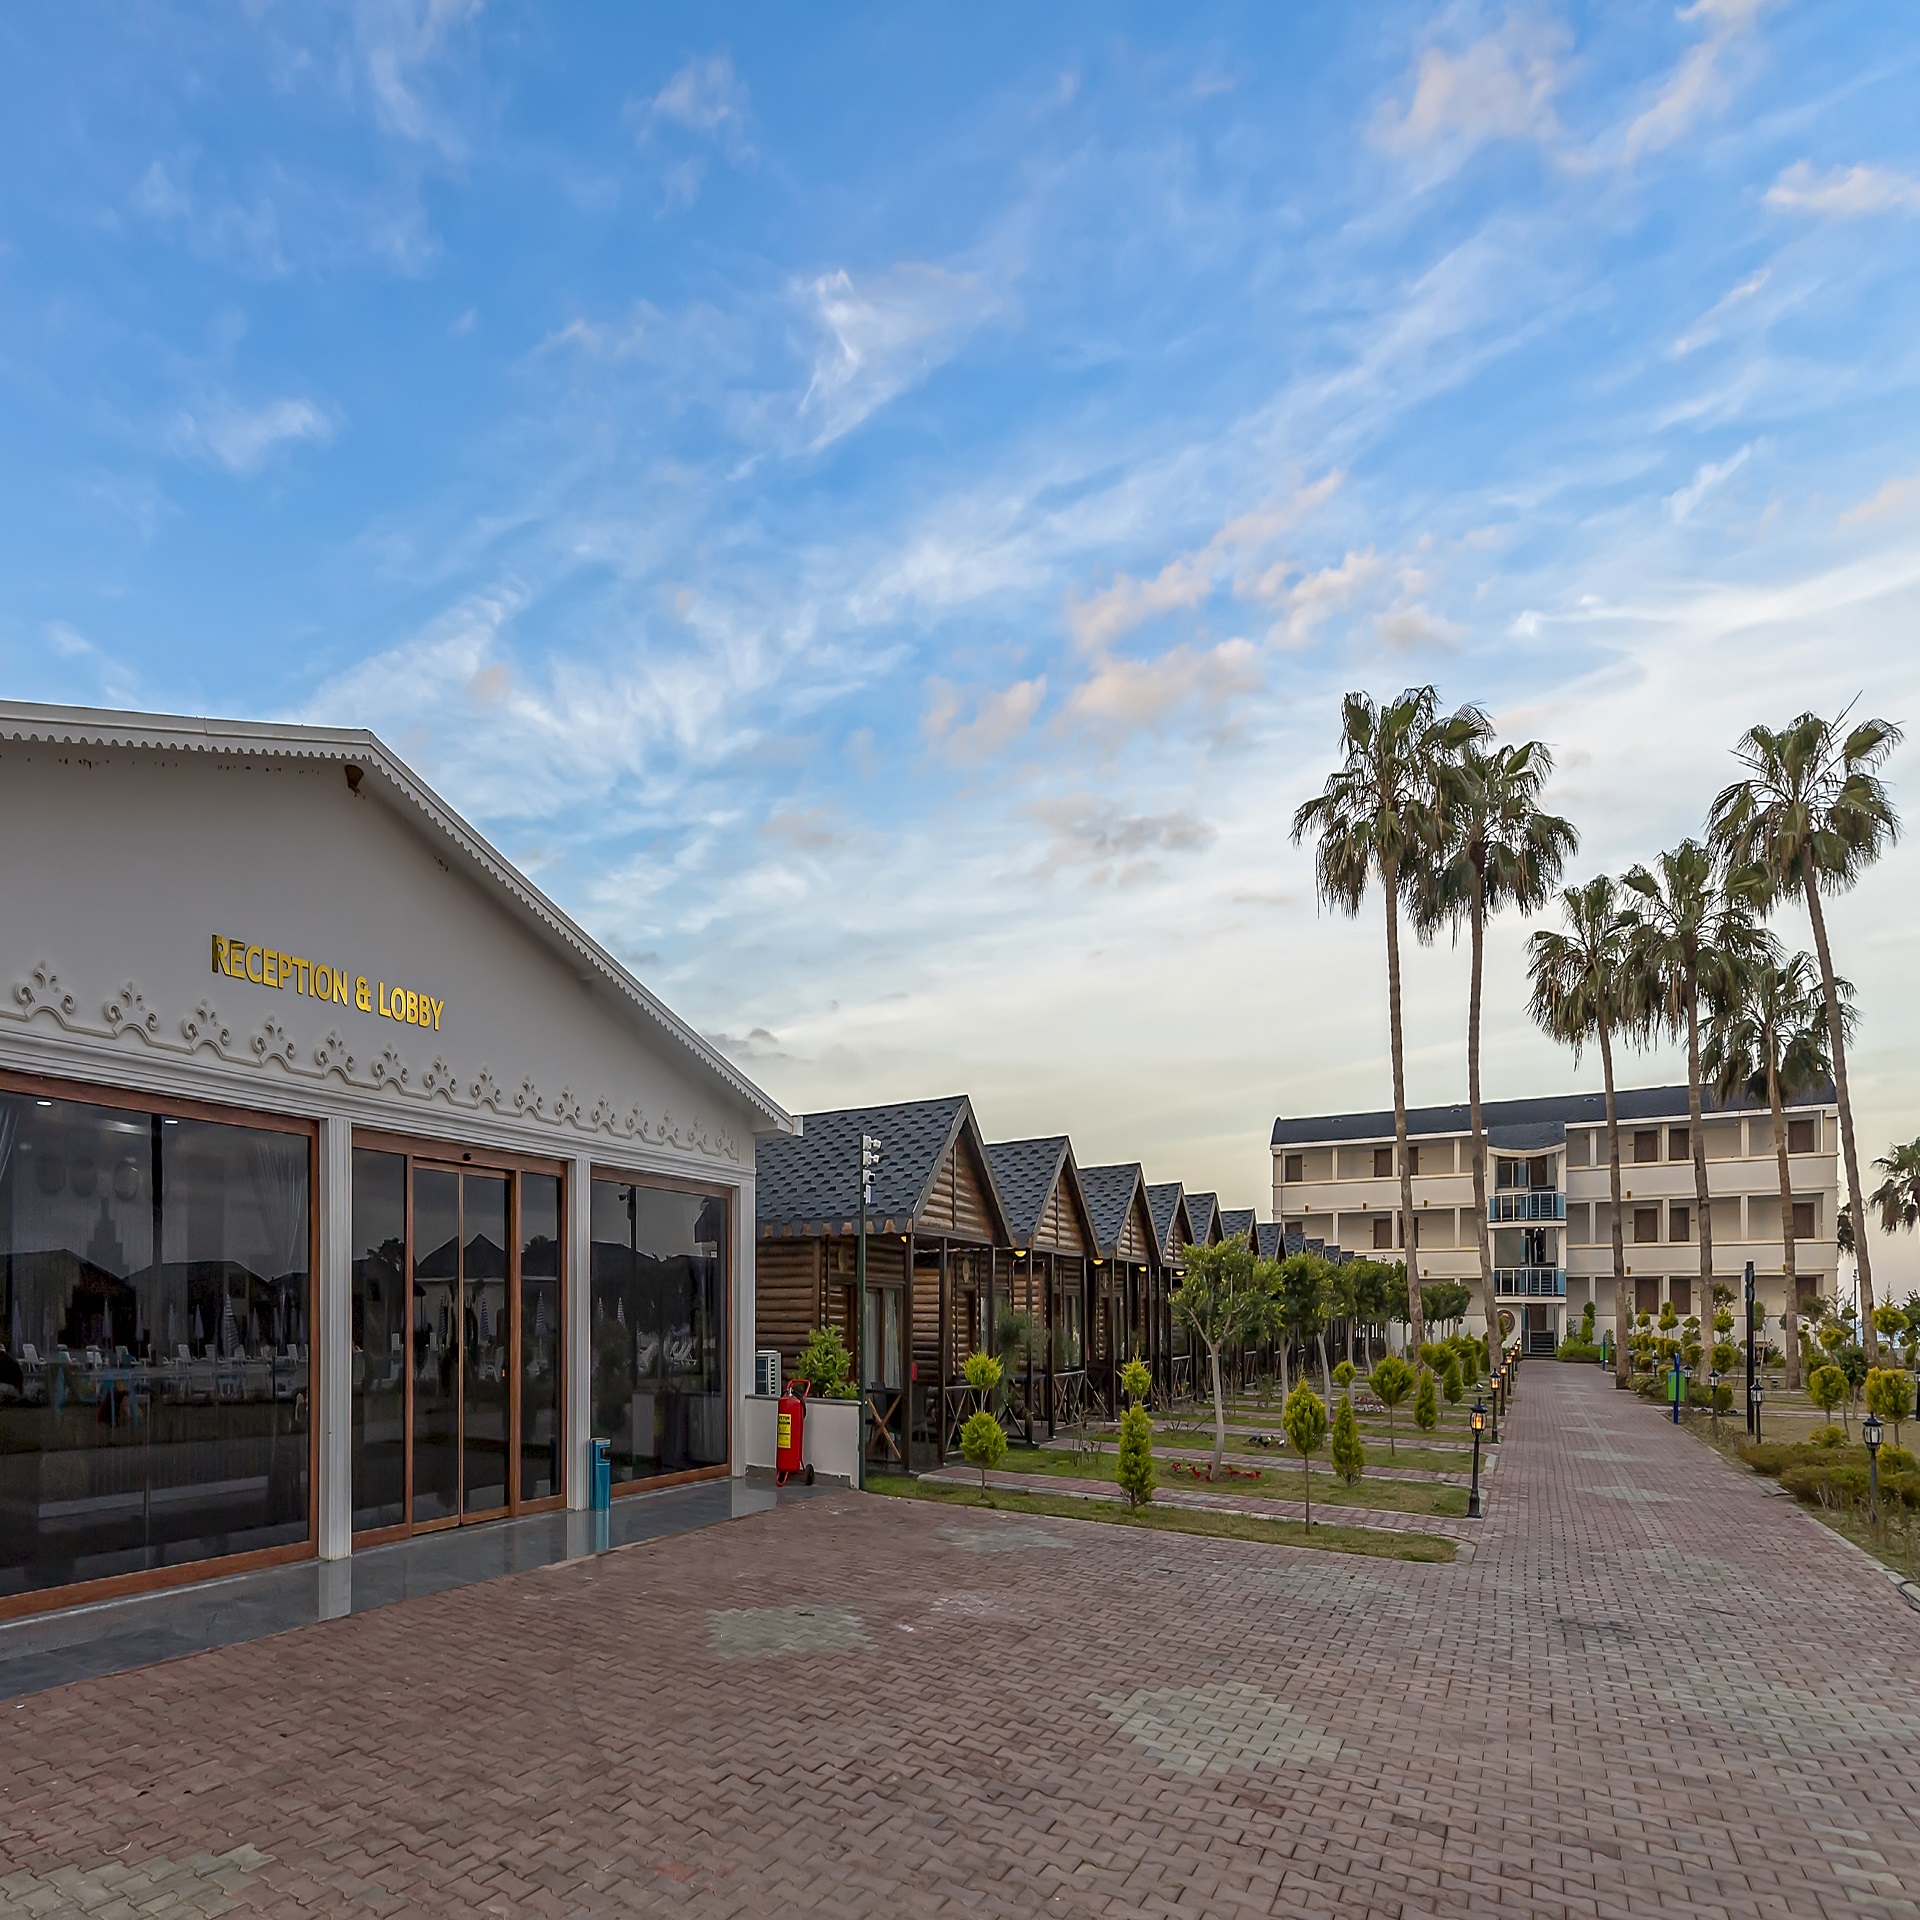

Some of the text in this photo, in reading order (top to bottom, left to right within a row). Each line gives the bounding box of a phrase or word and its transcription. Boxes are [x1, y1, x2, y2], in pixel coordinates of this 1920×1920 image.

[211, 933, 445, 1031] RECEPTION & LOBBY
